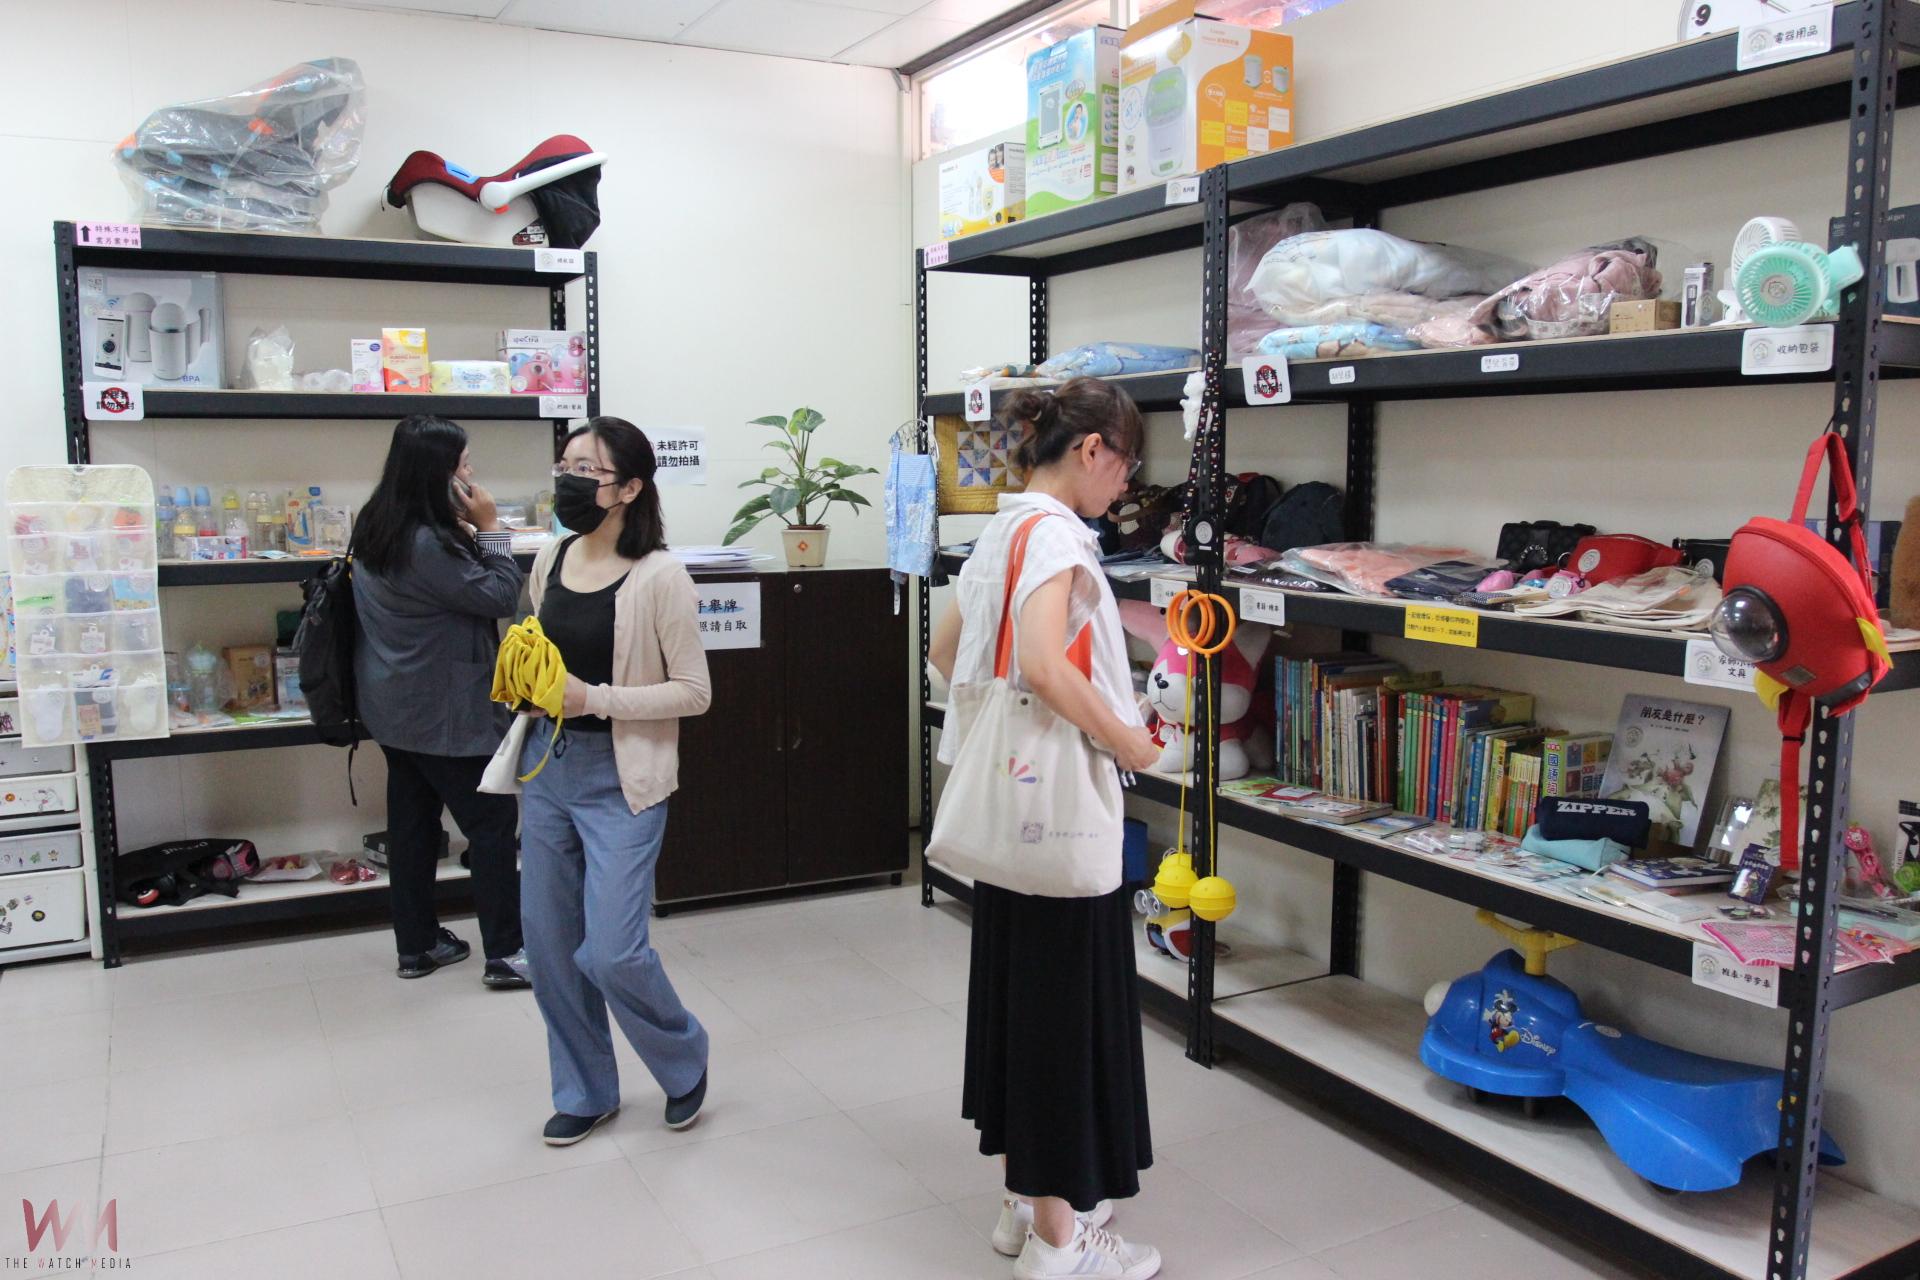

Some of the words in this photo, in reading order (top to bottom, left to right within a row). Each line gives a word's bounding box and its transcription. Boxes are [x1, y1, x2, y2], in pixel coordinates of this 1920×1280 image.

[1695, 4, 1712, 27] 9
[657, 440, 699, 451] 未經許可
[657, 455, 700, 467] 請勿拍攝
[1727, 666, 1747, 679] 文具
[1556, 800, 1637, 817] ZIPPER
[1520, 1027, 1557, 1056] Disney
